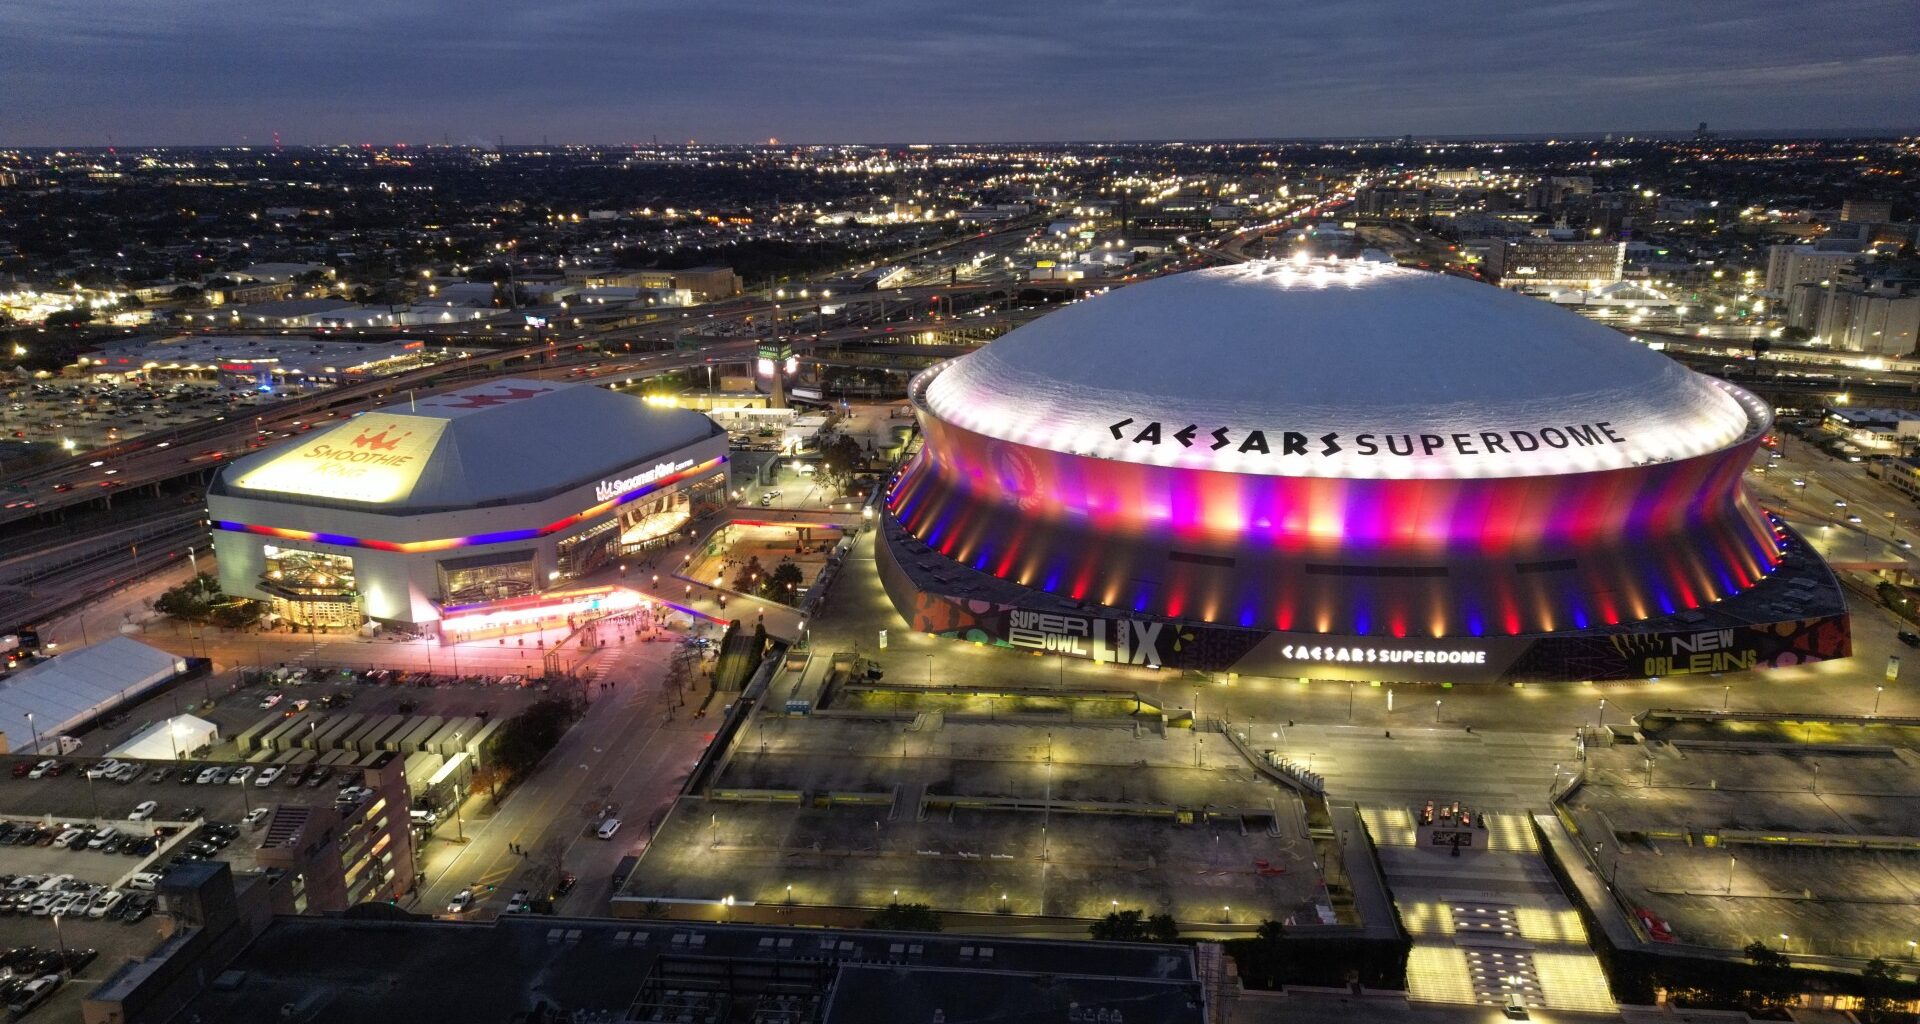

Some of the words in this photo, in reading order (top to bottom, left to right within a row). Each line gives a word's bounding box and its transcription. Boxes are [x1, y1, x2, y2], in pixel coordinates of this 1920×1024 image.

[1109, 417, 1342, 457] CAESARS
[1355, 421, 1626, 456] SUPERDOME
[304, 445, 413, 466] SMOOTHIE
[1010, 610, 1088, 636] SUPER
[1009, 628, 1087, 655] BOWL
[1093, 618, 1163, 665] LIX
[1282, 645, 1377, 663] CAESARS
[1379, 649, 1486, 664] SUPERDOME
[1671, 629, 1734, 656] NEW
[1644, 649, 1758, 676] ORLEANS
